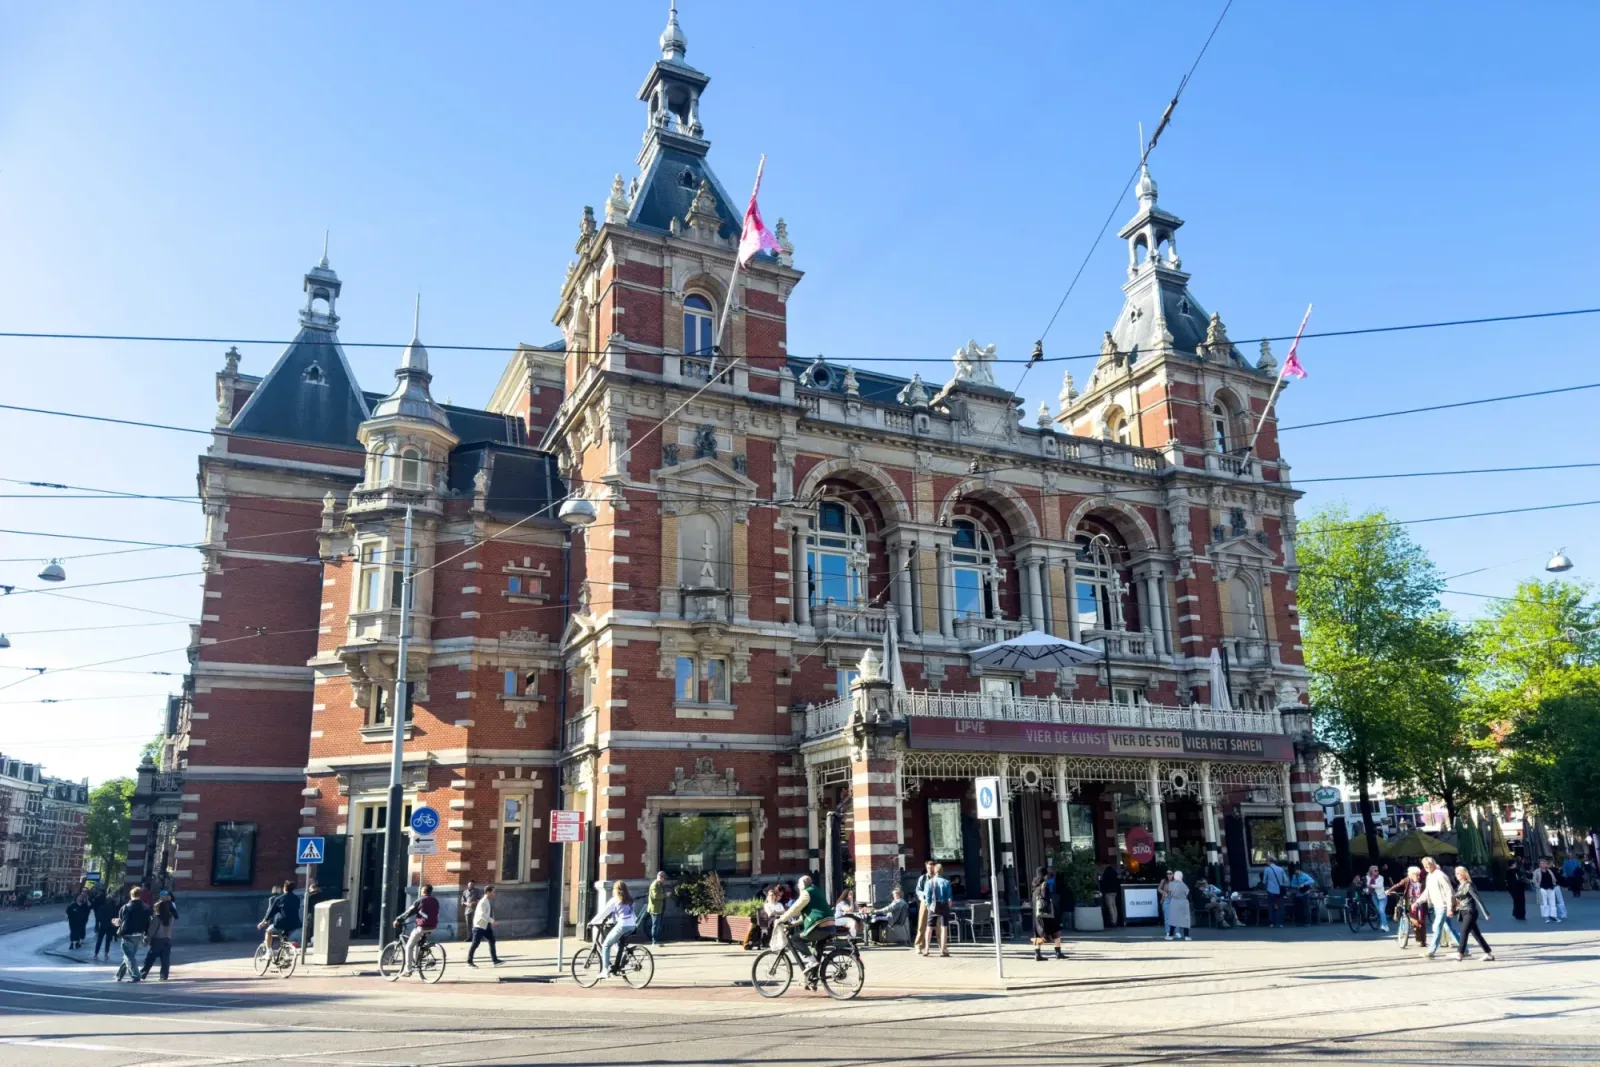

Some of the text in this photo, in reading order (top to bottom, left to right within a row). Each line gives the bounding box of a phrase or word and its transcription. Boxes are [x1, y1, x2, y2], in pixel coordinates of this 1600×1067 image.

[1025, 728, 1263, 752] VIER DE KUNST VIER DE STAD VIER HET SAMEN
